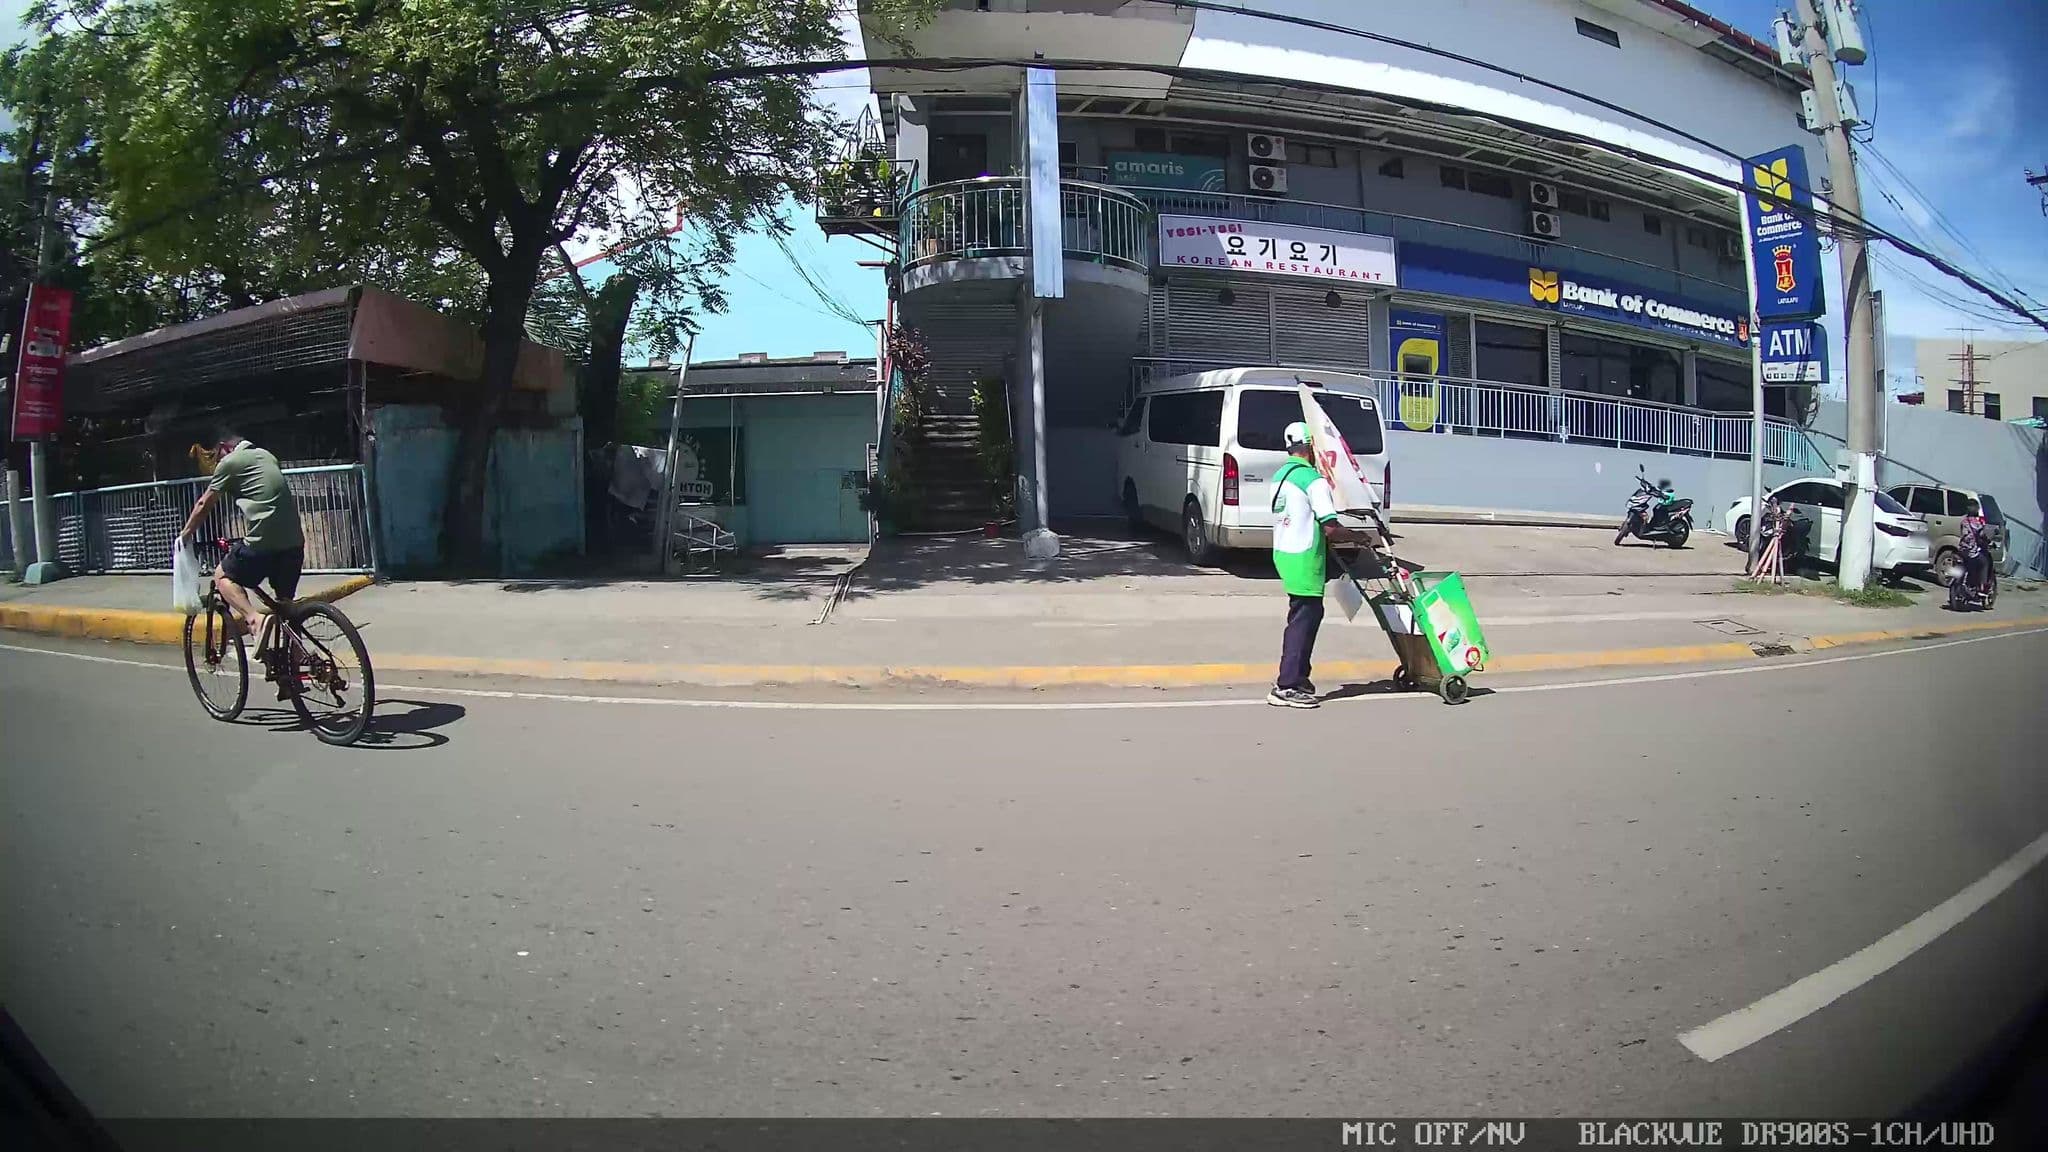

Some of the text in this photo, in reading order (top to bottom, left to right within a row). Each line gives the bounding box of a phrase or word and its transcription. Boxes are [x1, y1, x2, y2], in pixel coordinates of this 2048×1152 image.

[1114, 161, 1184, 175] amaris
[1757, 220, 1802, 236] Commerce
[1761, 212, 1784, 225] Bank
[1226, 235, 1337, 266] 요기요기
[1177, 255, 1382, 281] KOREAN RESTAURANT
[1562, 280, 1619, 309] Bank
[1620, 294, 1643, 313] of
[1645, 299, 1735, 335] Commerce
[1769, 328, 1812, 356] ATM
